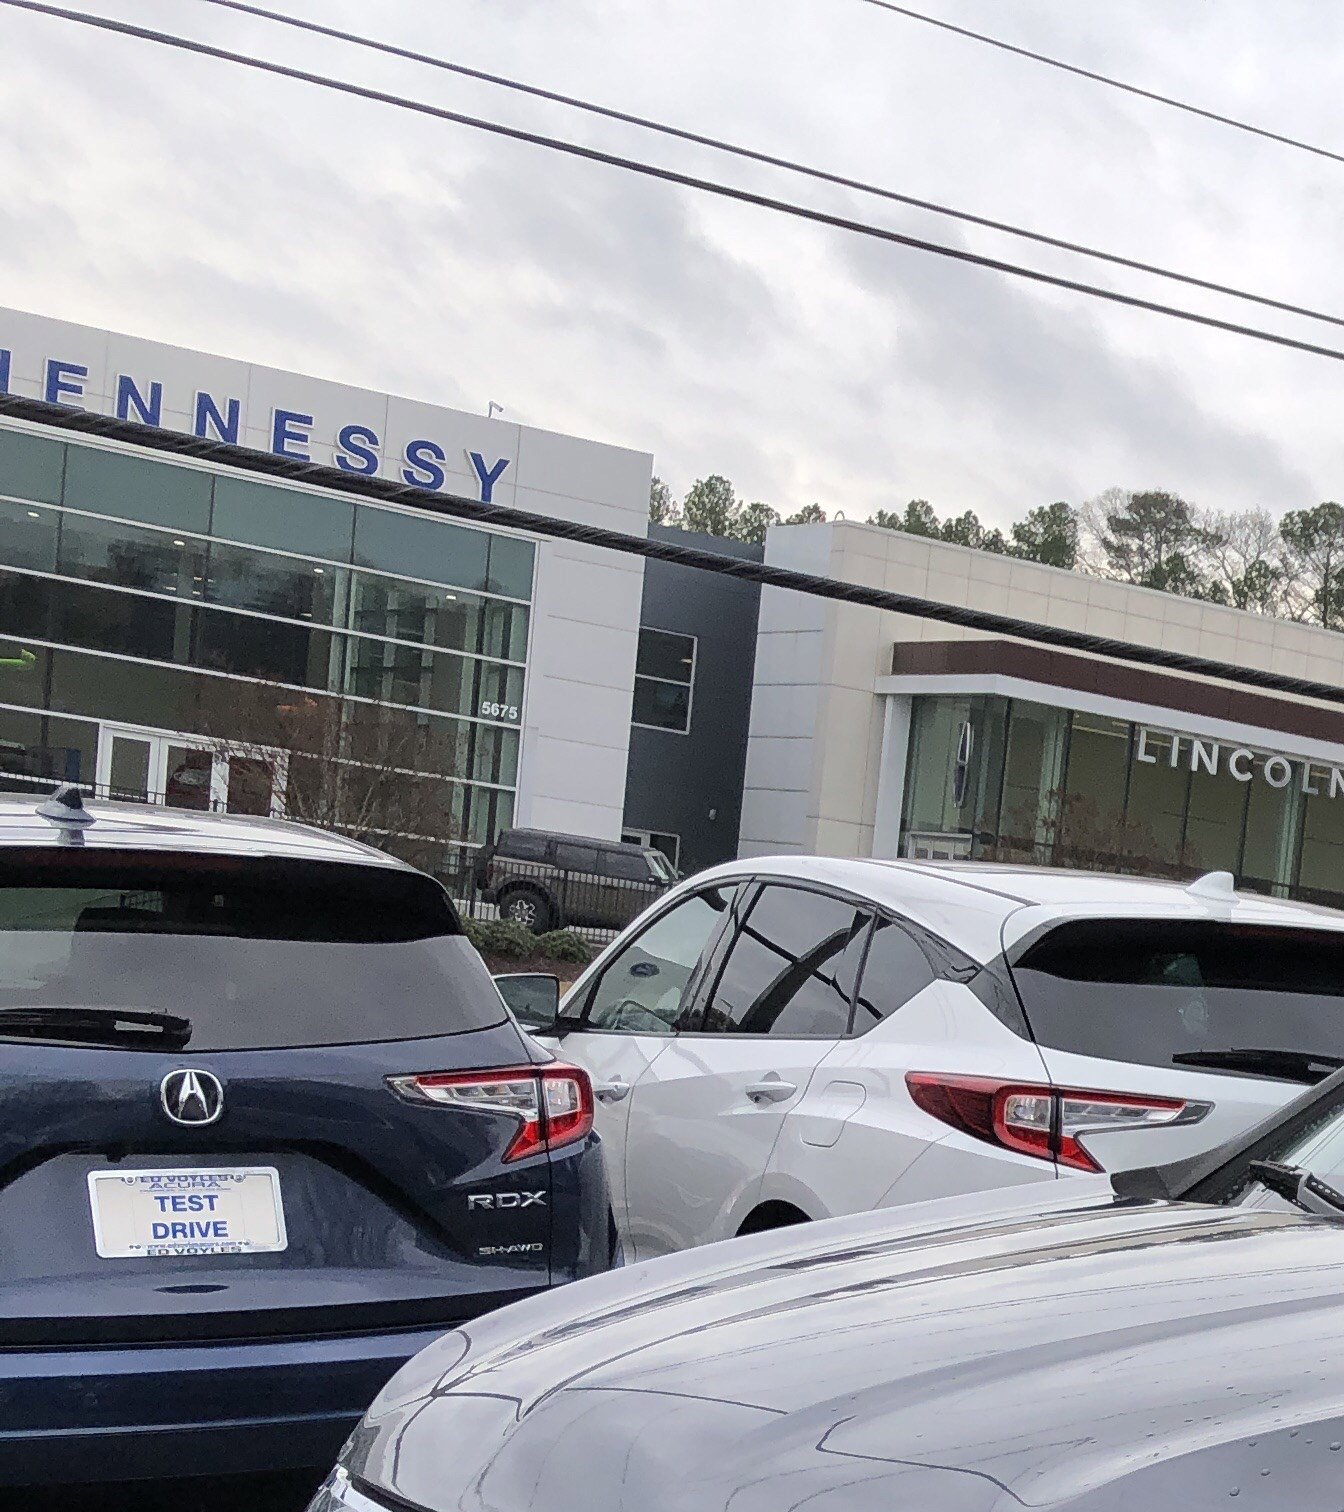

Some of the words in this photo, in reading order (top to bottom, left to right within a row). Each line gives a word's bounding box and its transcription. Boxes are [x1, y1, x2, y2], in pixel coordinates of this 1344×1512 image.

[0, 349, 511, 502] ENNESSY
[481, 701, 518, 719] 5675
[149, 1181, 221, 1189] ACURA
[153, 1194, 219, 1212] TEST
[467, 1190, 547, 1210] RDX
[152, 1220, 228, 1240] DRIVE
